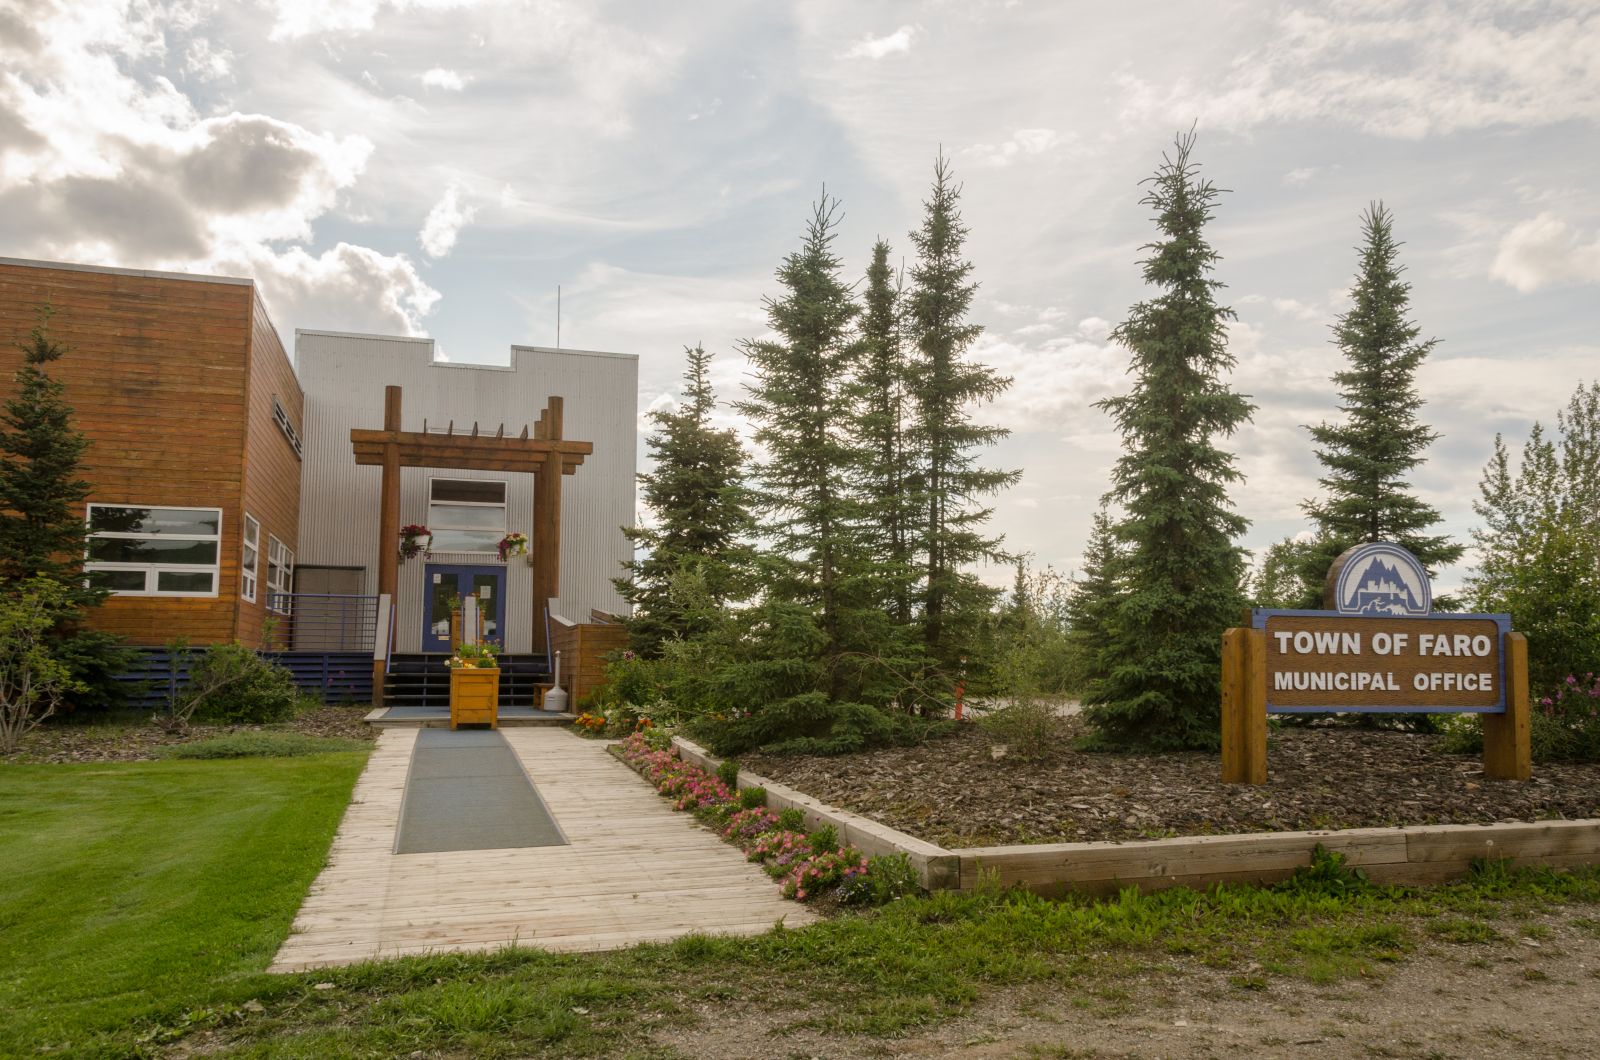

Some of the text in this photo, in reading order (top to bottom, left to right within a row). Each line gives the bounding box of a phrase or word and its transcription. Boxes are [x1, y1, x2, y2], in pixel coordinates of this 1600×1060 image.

[1274, 631, 1491, 657] TOWN OF FARO
[1274, 672, 1492, 691] MUNICIPAL OFFICE
